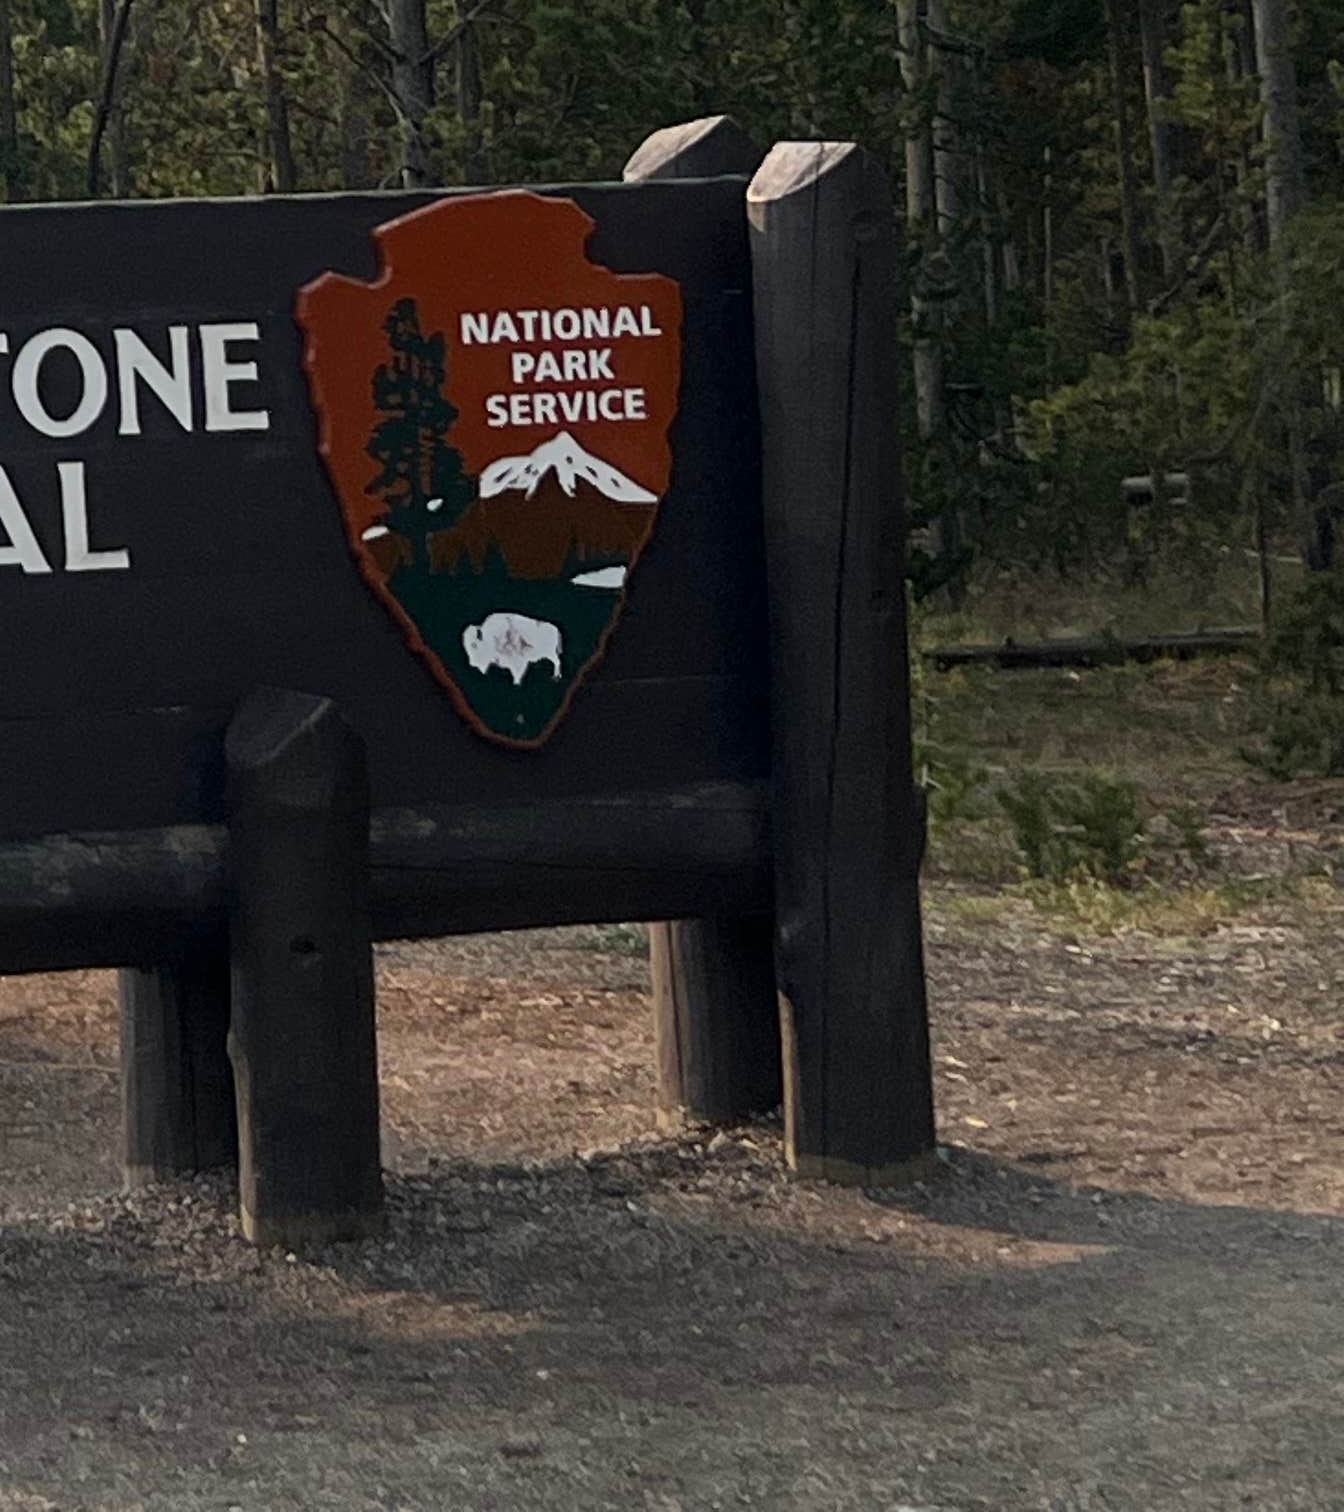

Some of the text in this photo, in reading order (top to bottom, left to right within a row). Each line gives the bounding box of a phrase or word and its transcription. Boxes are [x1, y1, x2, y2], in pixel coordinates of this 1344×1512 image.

[460, 305, 663, 345] NATIONAL
[511, 347, 616, 384] PARK
[485, 387, 647, 428] SERVICE
